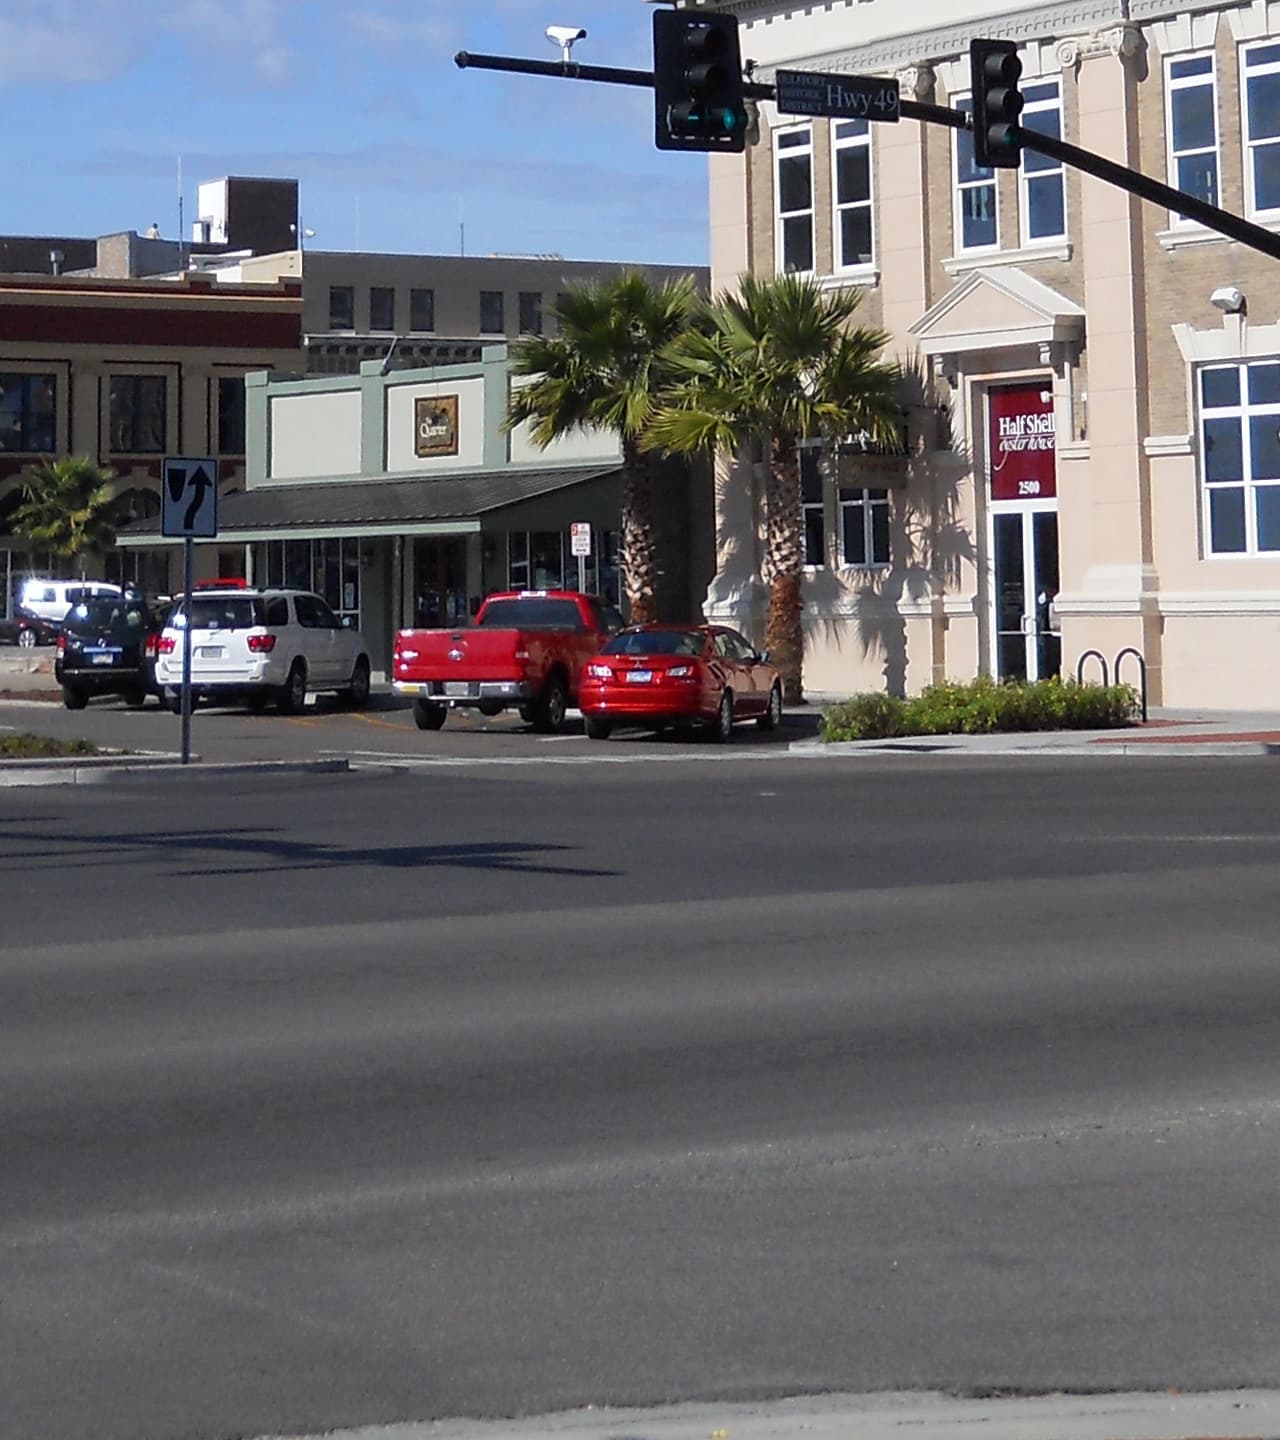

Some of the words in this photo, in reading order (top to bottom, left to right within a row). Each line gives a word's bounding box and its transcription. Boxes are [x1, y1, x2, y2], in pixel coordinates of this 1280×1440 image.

[827, 83, 873, 116] Hwy
[874, 88, 899, 113] 49
[998, 415, 1027, 436] Half
[1026, 412, 1057, 434] Shell
[1018, 480, 1041, 495] 2500
